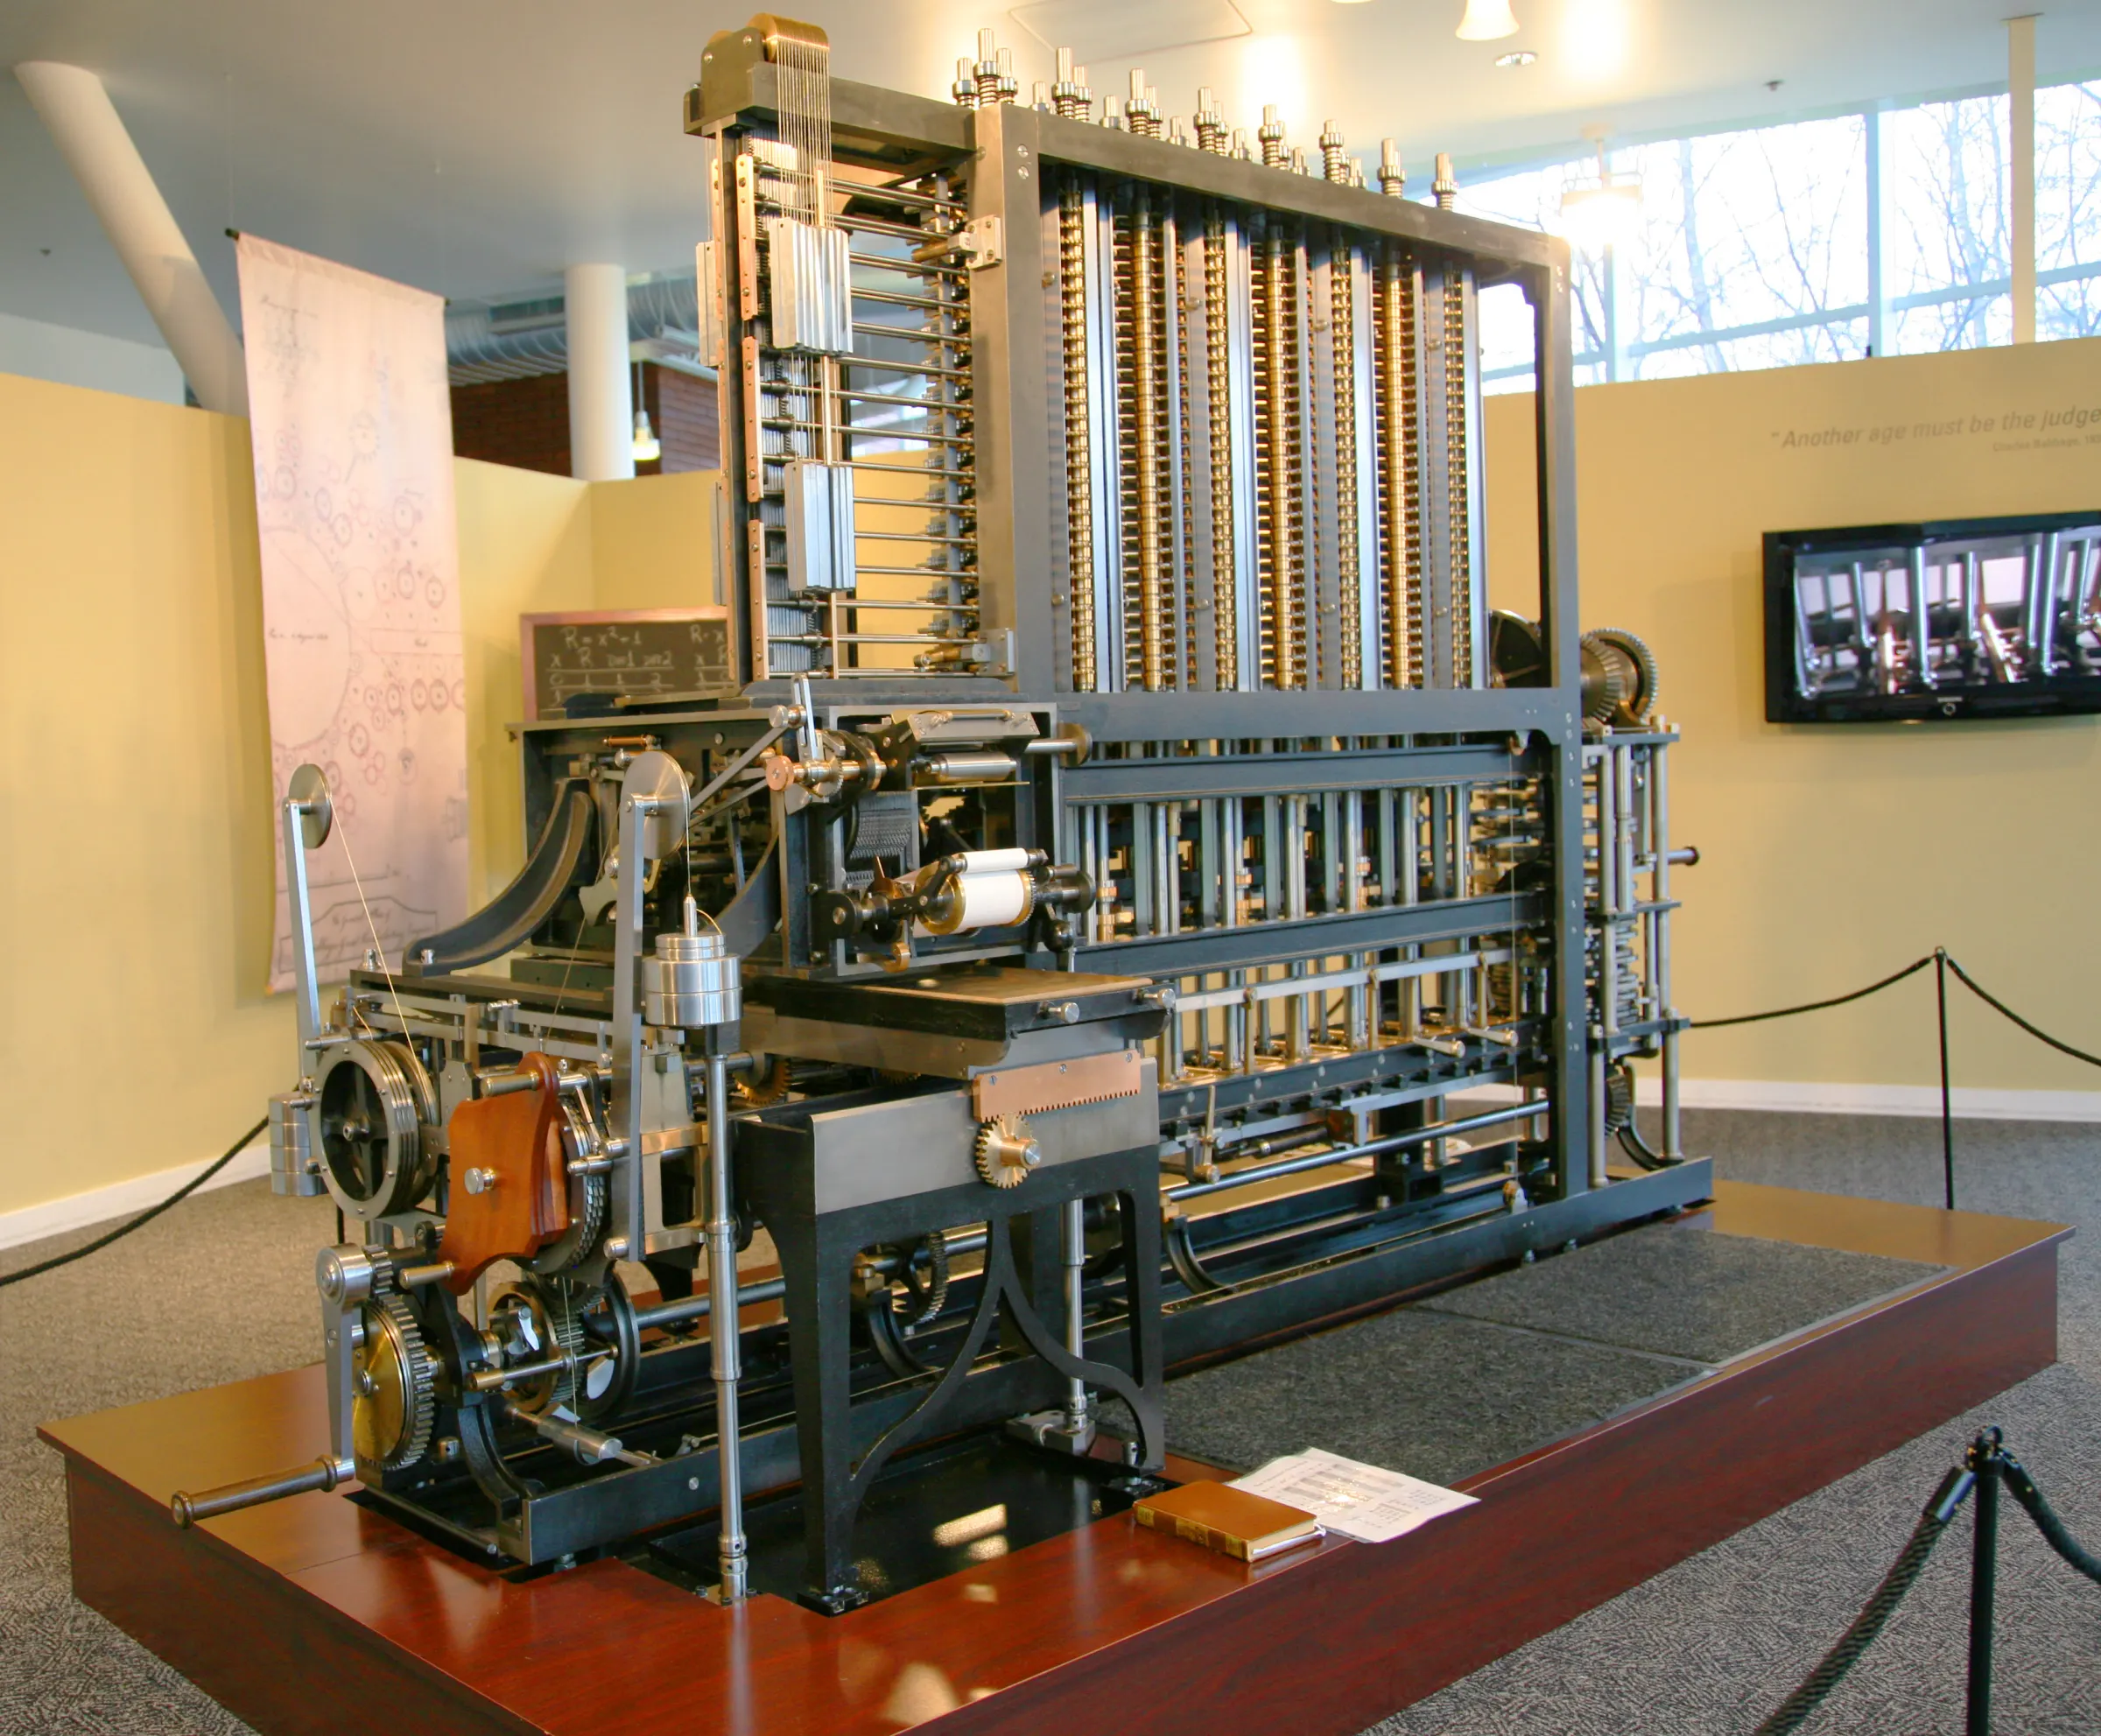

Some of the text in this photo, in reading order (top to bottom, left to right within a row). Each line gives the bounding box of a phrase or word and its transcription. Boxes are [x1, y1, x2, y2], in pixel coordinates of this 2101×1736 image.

[1867, 424, 1908, 446] age
[1912, 417, 1965, 439] must
[1969, 413, 1995, 434] be
[2001, 410, 2037, 431] the
